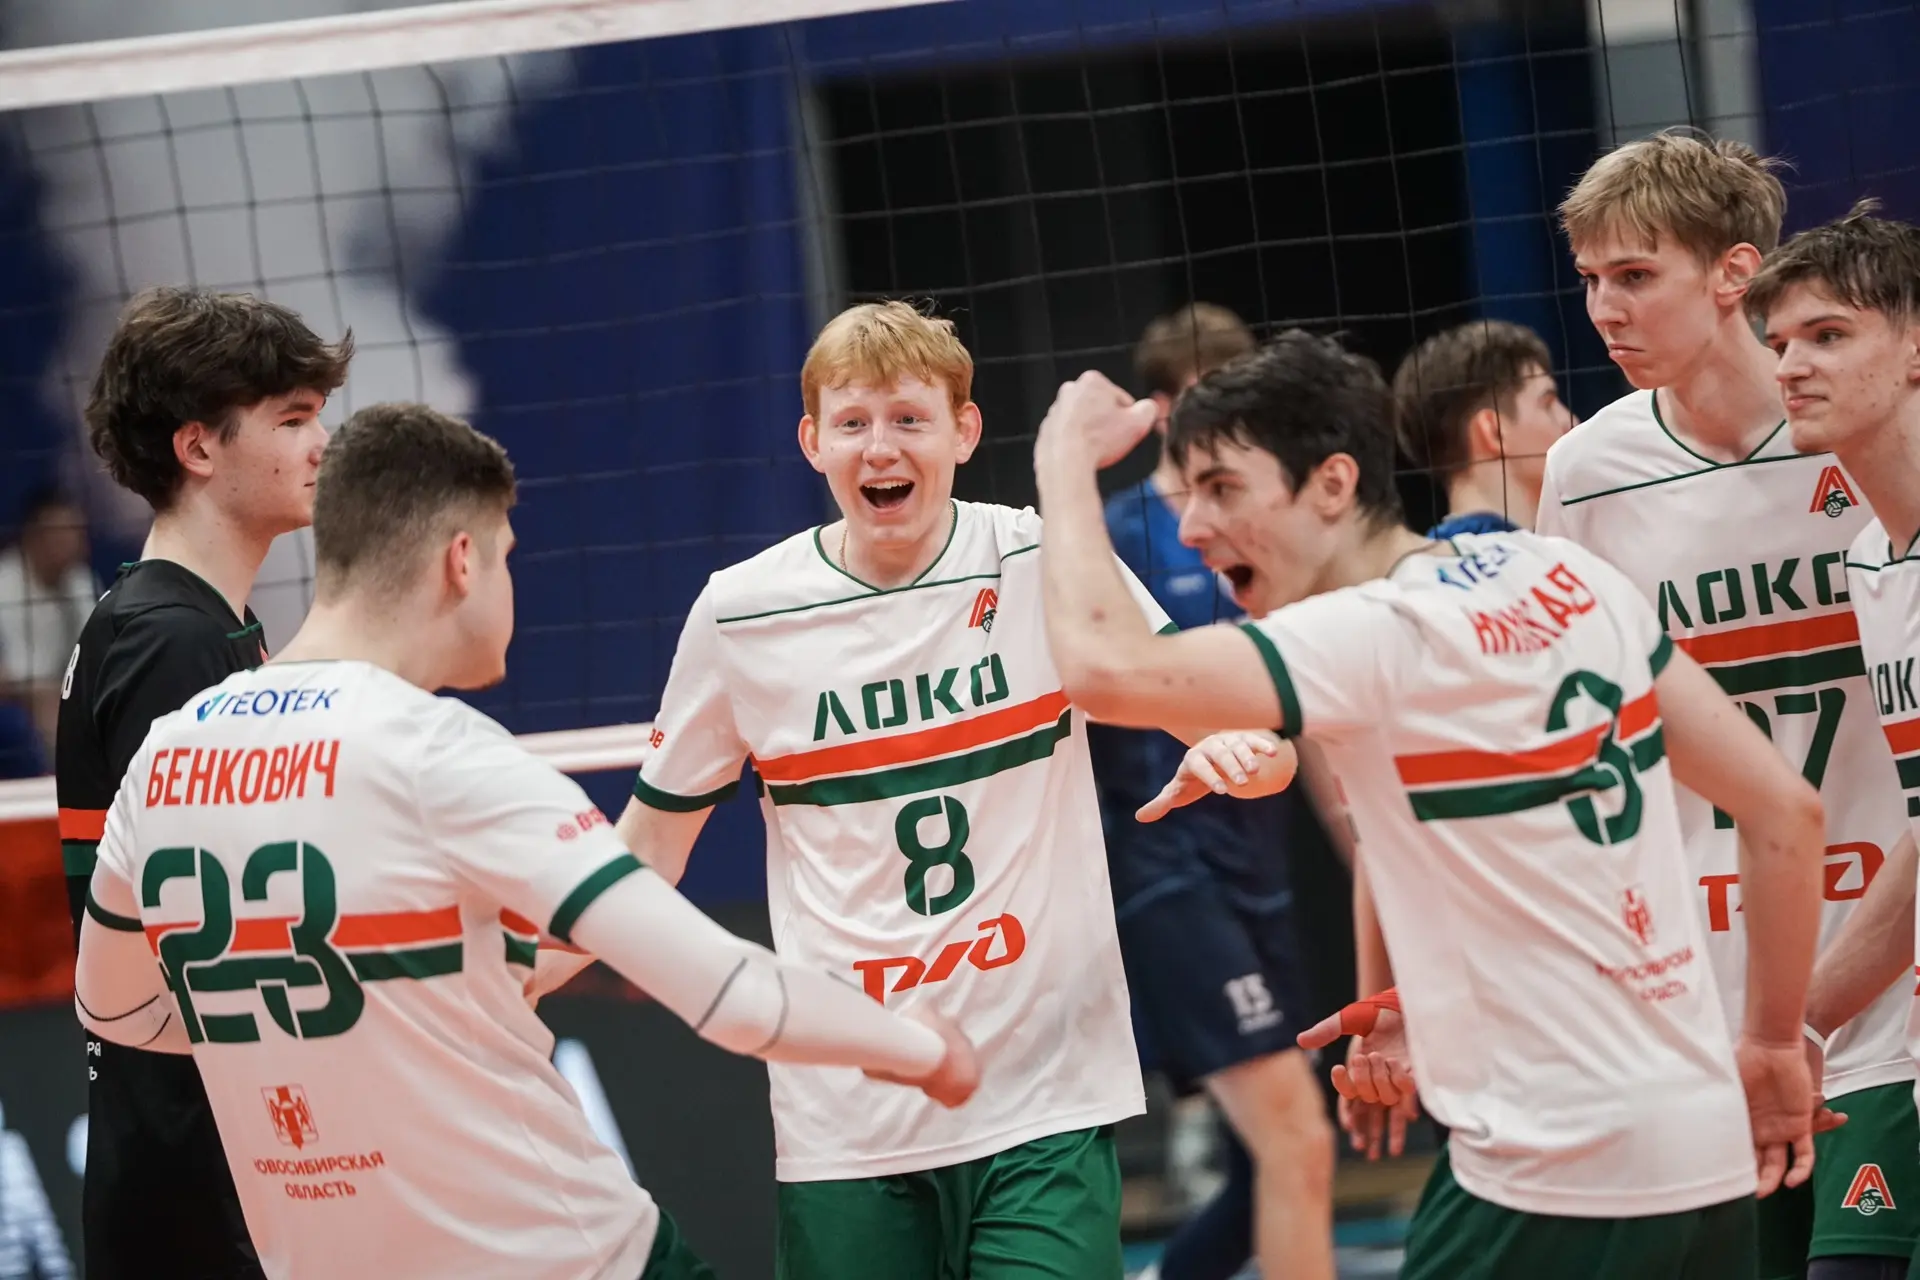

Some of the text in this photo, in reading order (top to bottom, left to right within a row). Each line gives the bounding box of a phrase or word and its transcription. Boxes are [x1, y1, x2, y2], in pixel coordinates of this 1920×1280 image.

[218, 687, 341, 717] ГЕОТЕК
[813, 652, 1011, 742] ЛОКО
[146, 739, 341, 808] БЕНКОВИЧ
[1546, 669, 1643, 846] 3
[894, 795, 976, 917] 8
[142, 840, 365, 1044] 23
[285, 1180, 356, 1201] ОБЛАСТЬ
